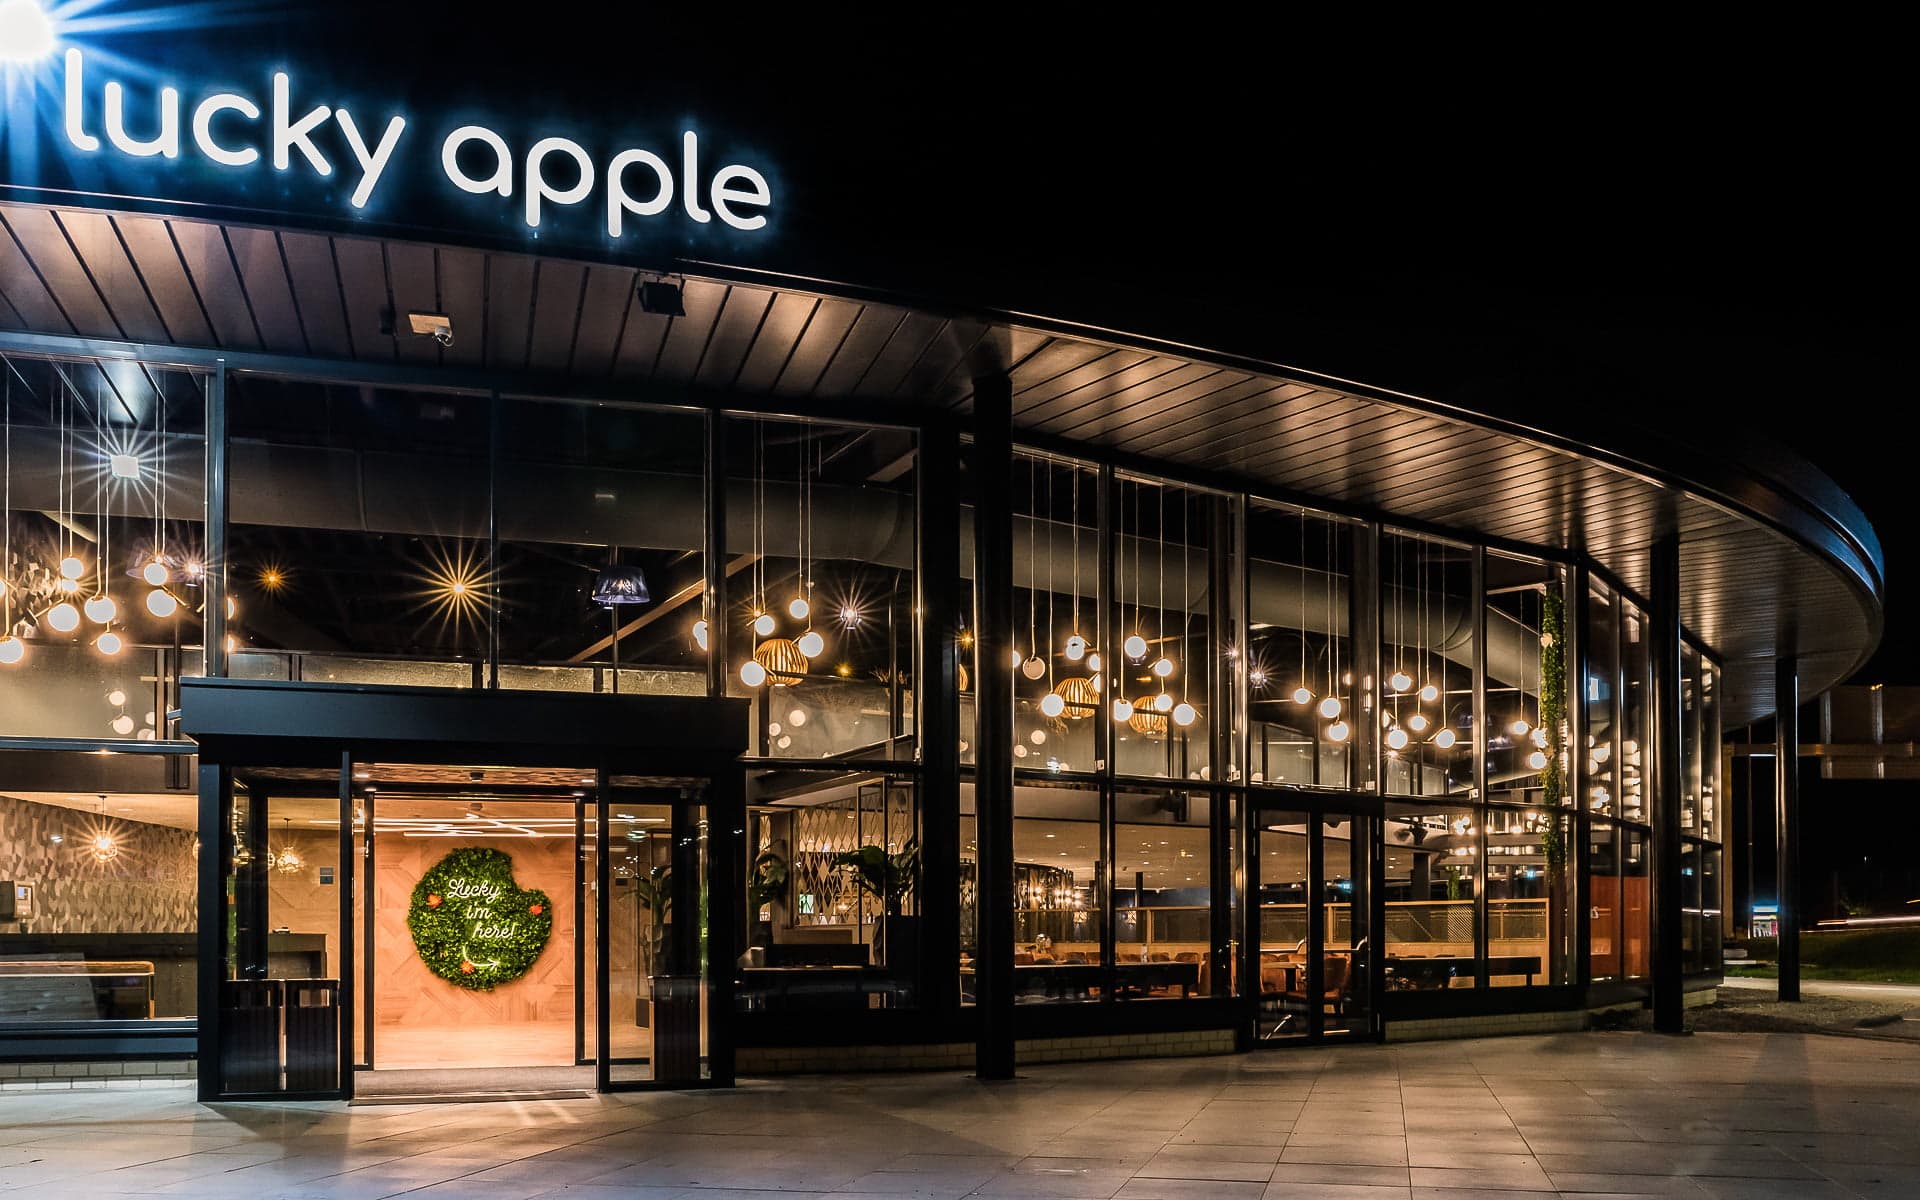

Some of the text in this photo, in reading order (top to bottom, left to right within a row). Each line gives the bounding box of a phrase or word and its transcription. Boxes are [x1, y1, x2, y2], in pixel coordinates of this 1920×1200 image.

[65, 48, 771, 238] lucky apple
[447, 878, 500, 904] Lucky
[472, 921, 516, 939] here!
